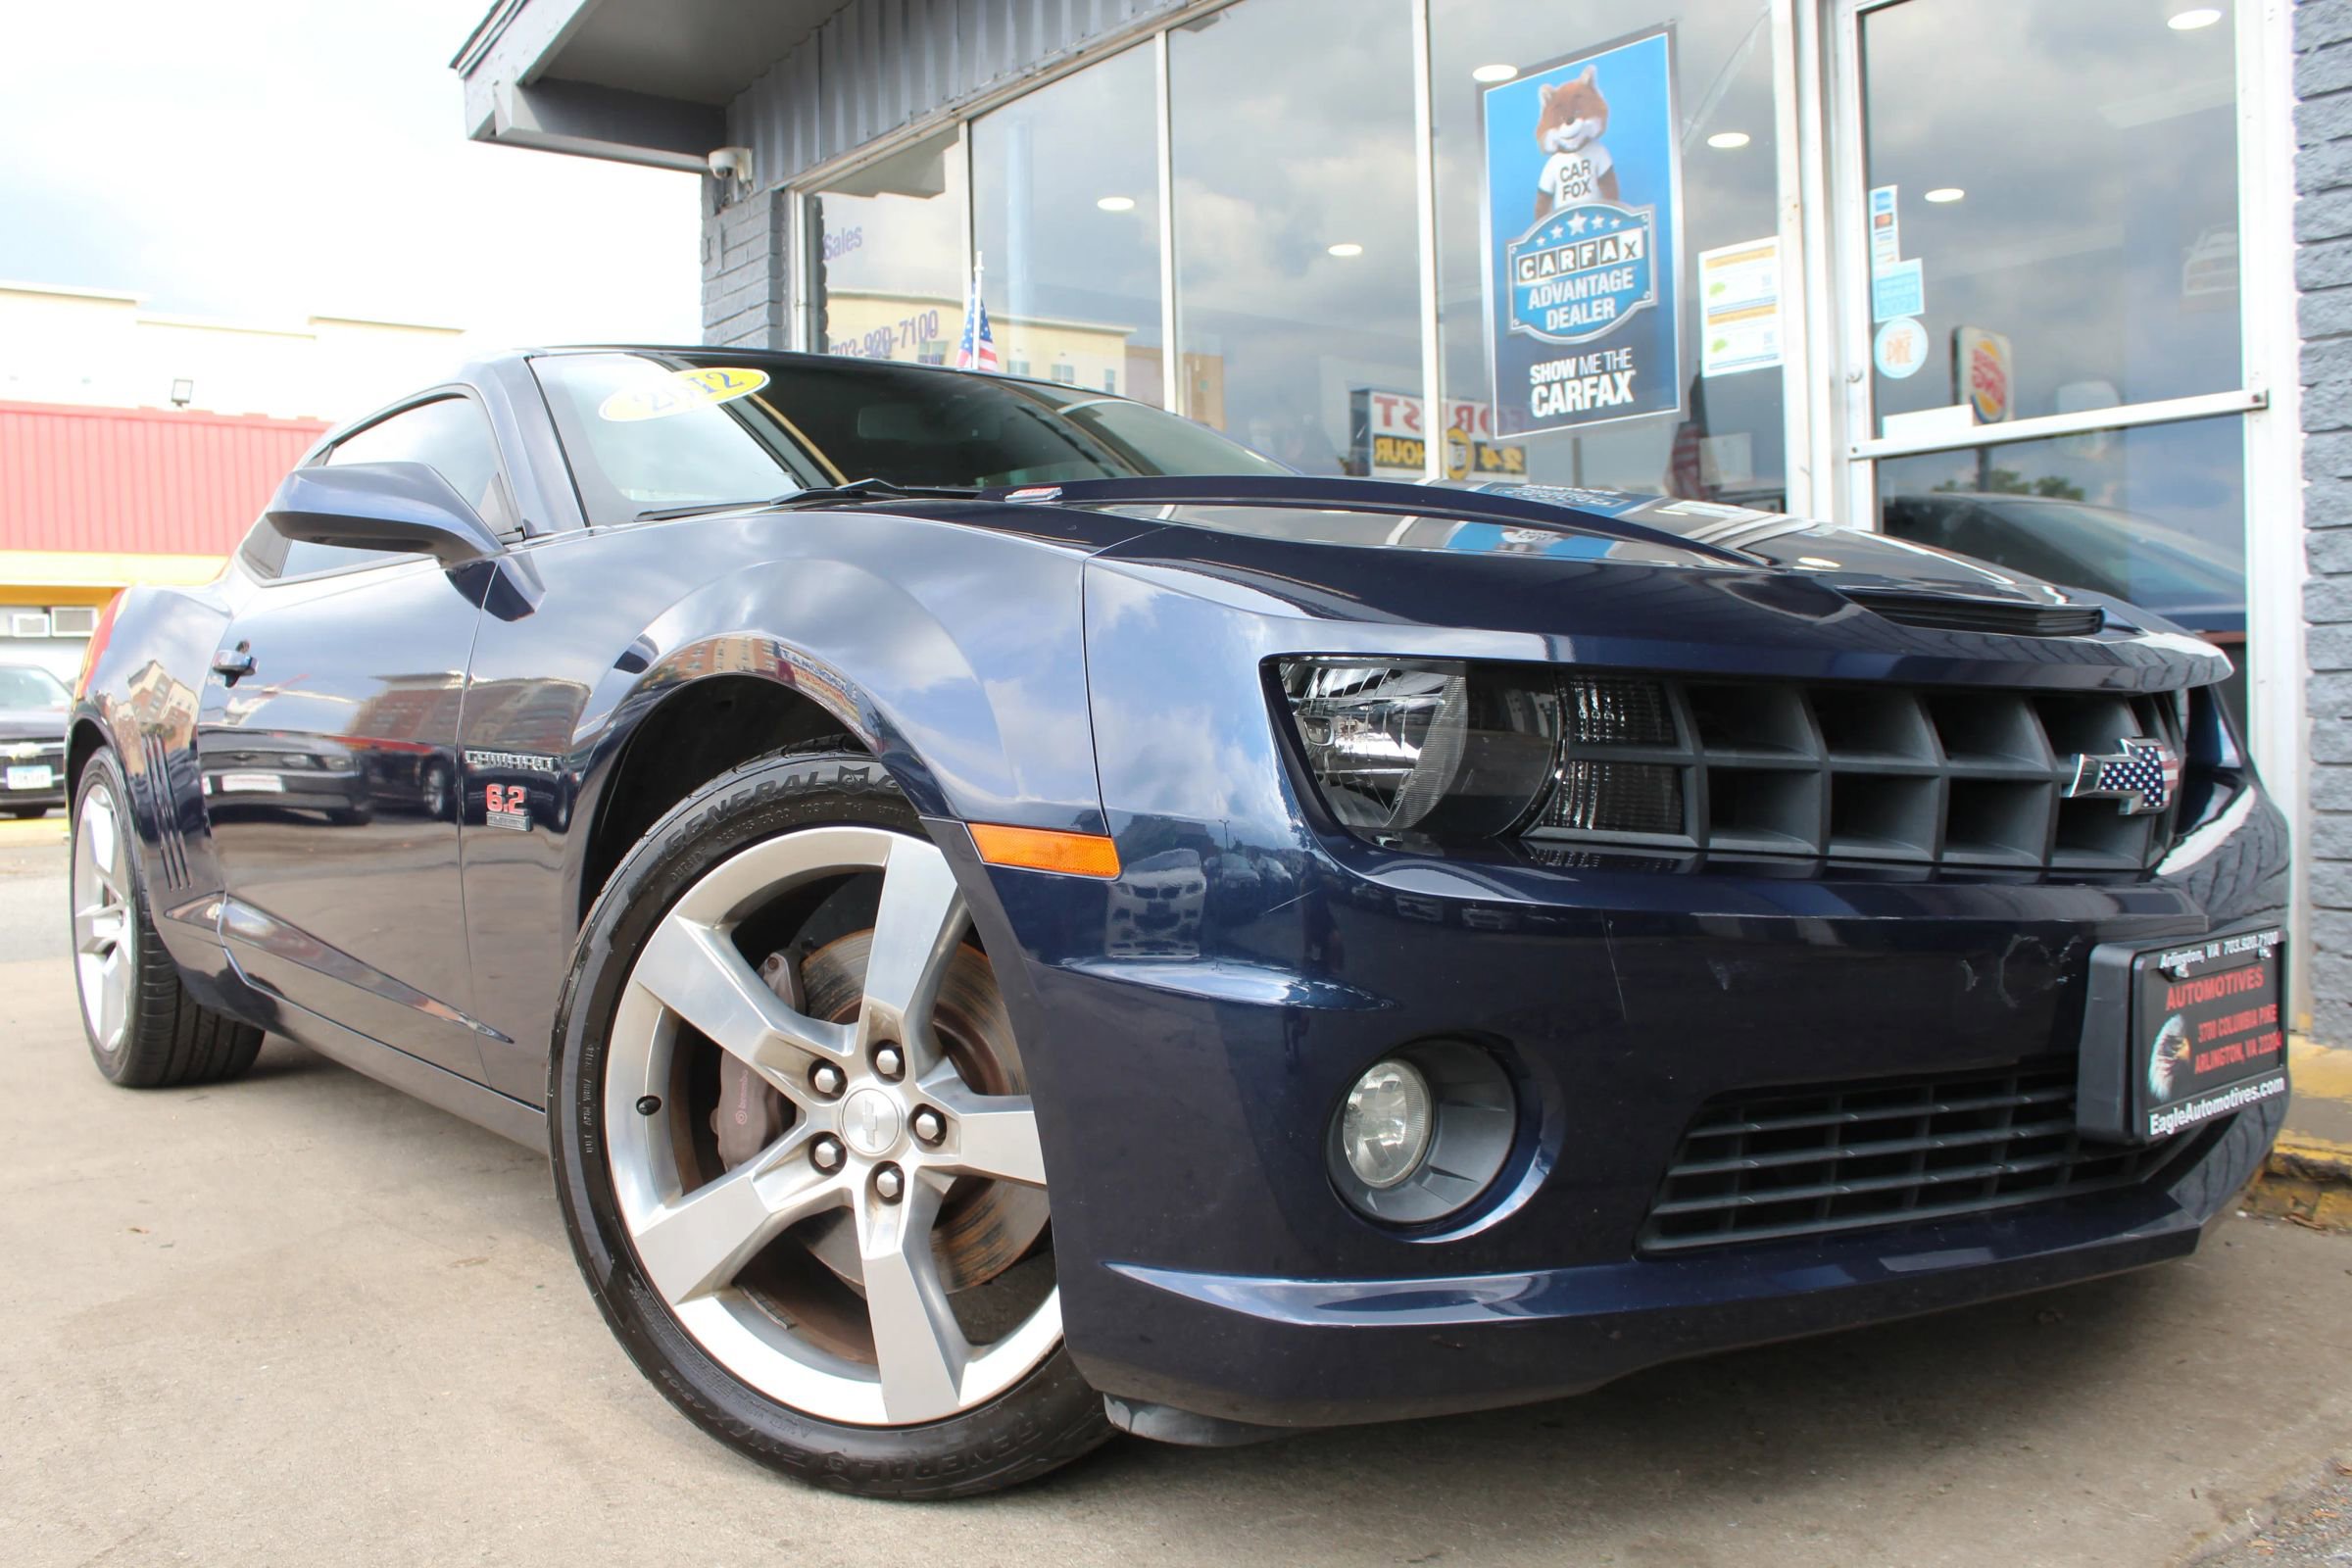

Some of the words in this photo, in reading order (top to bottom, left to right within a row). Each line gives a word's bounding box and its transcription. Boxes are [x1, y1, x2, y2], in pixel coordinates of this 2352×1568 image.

[1560, 160, 1592, 183] CAR
[1562, 178, 1592, 202] FOX
[823, 225, 862, 261] Sales
[1520, 239, 1639, 280] CARFAX
[1528, 266, 1635, 311] ADVANTAGE
[1545, 297, 1616, 331] DEALER
[1530, 357, 1577, 385] SHOW
[1578, 353, 1602, 376] ME
[1604, 347, 1633, 371] THE
[1531, 370, 1636, 418] CARFAX
[486, 783, 527, 817] 6.2
[662, 769, 828, 860] GENERAL
[2206, 943, 2221, 958] VA
[2166, 965, 2265, 1011] AUTOMOTIVES
[2149, 1077, 2285, 1136] EagleAutomotives.com
